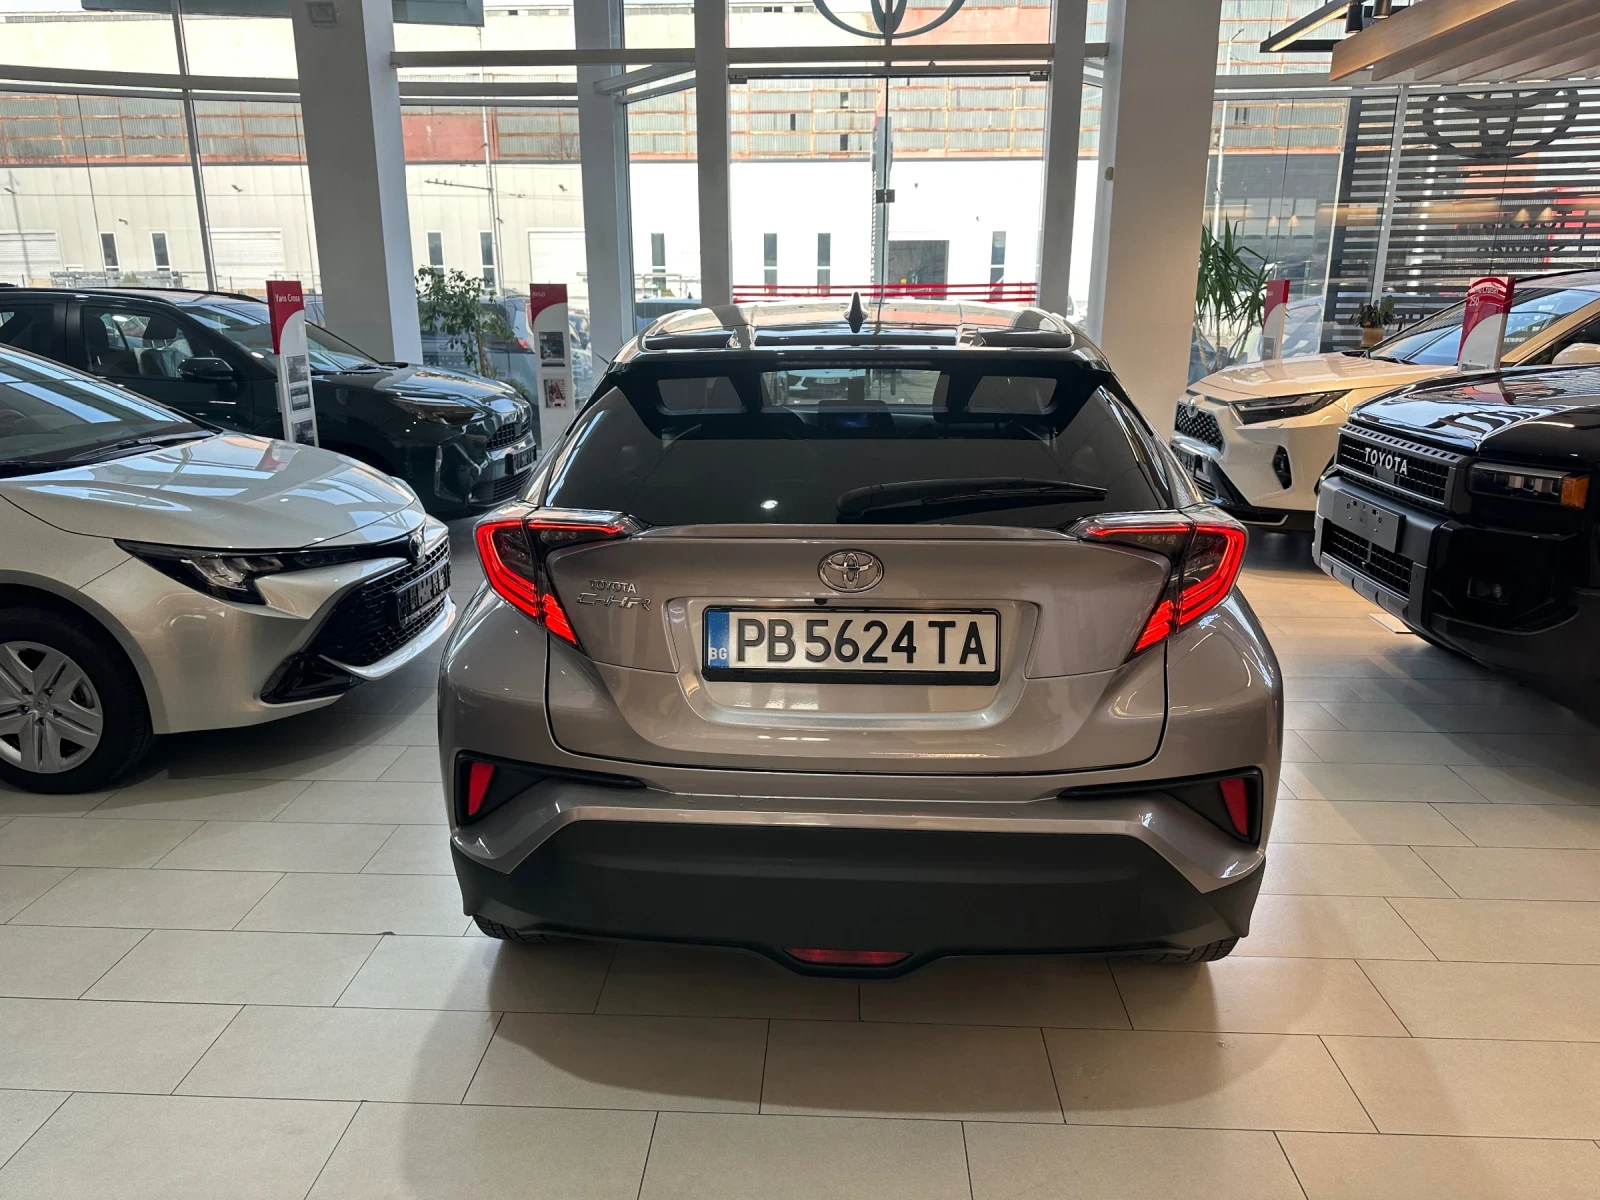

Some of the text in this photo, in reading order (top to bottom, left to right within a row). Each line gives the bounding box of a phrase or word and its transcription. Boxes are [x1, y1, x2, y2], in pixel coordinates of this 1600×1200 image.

[275, 293, 301, 302] Yaris Cross
[1469, 296, 1480, 307] 250
[1365, 447, 1408, 476] TOYOTA
[589, 579, 637, 594] TOYOTA
[577, 592, 652, 611] C-HR
[736, 618, 987, 665] PB 5624 TA
[709, 647, 727, 661] BG
